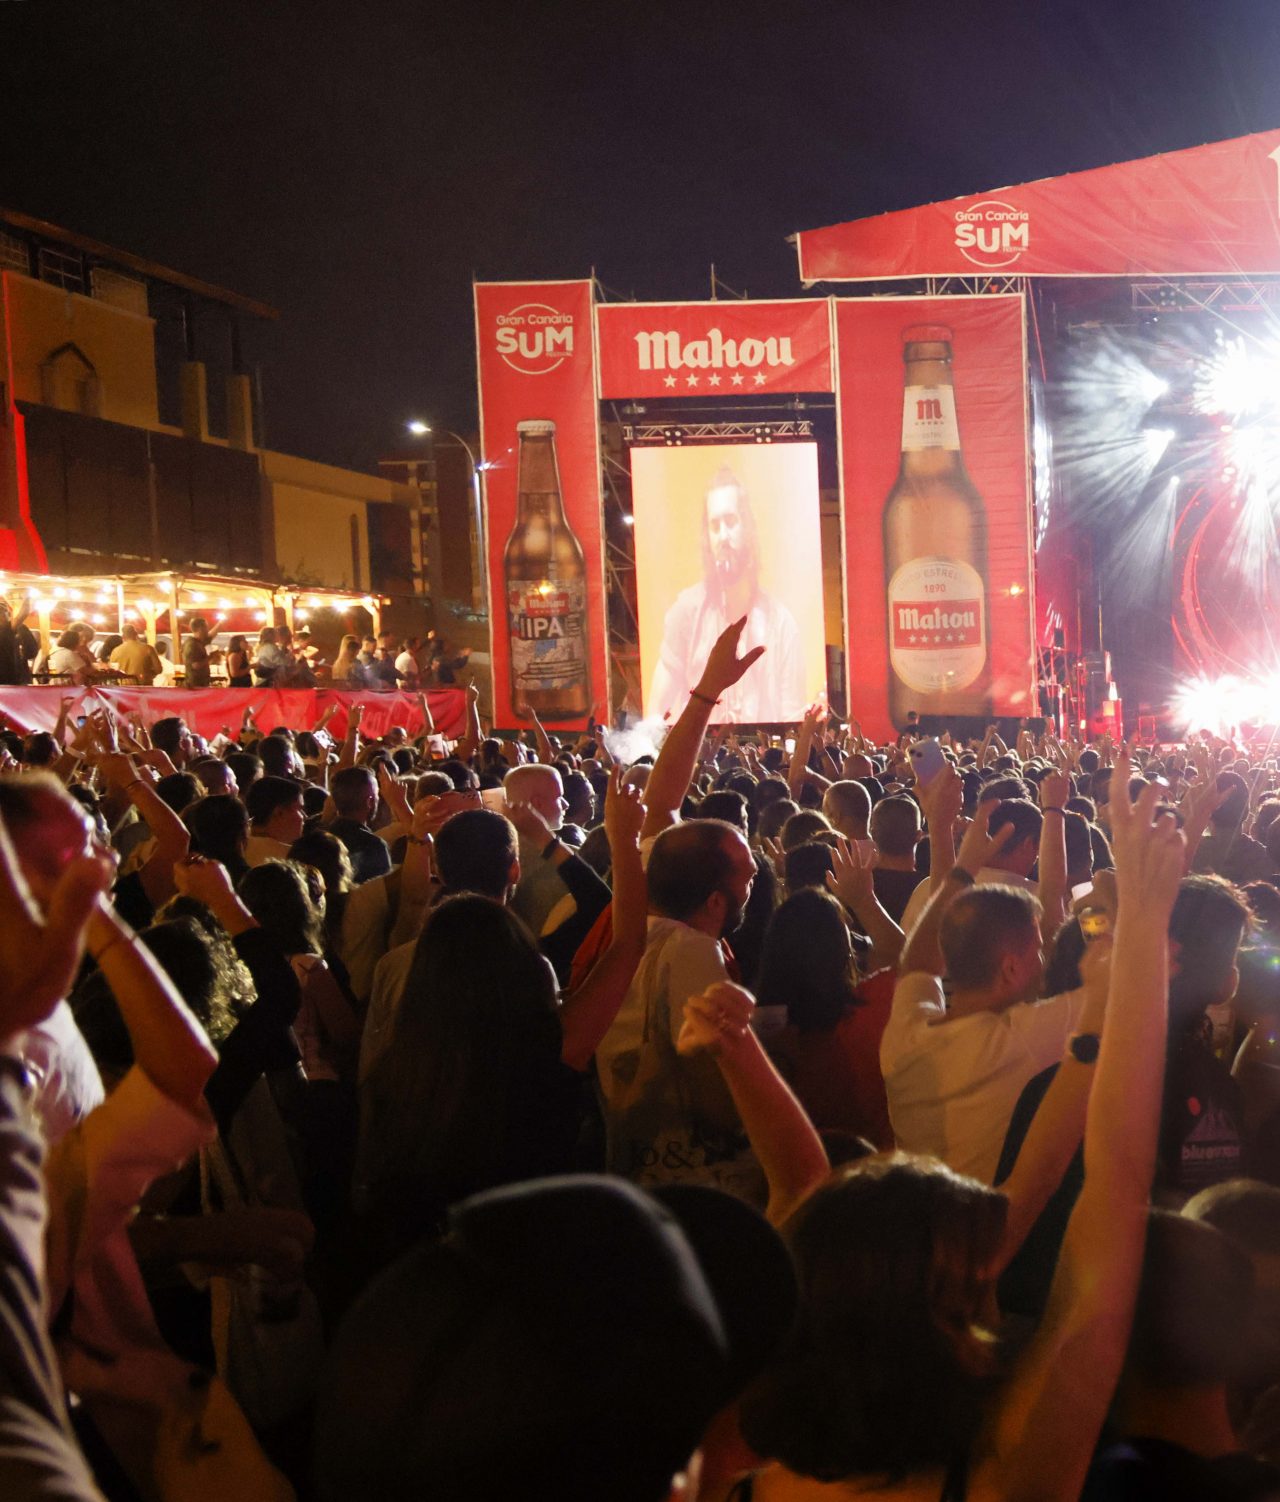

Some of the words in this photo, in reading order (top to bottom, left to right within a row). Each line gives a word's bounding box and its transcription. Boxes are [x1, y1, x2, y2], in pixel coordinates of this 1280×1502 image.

[955, 211, 983, 222] Gran
[985, 210, 1029, 221] Canaria
[954, 222, 1029, 253] SUM
[496, 315, 525, 326] Gran
[527, 313, 574, 325] Canaria
[495, 326, 574, 359] SUM
[634, 328, 796, 370] Mahou
[898, 607, 975, 630] Mahou
